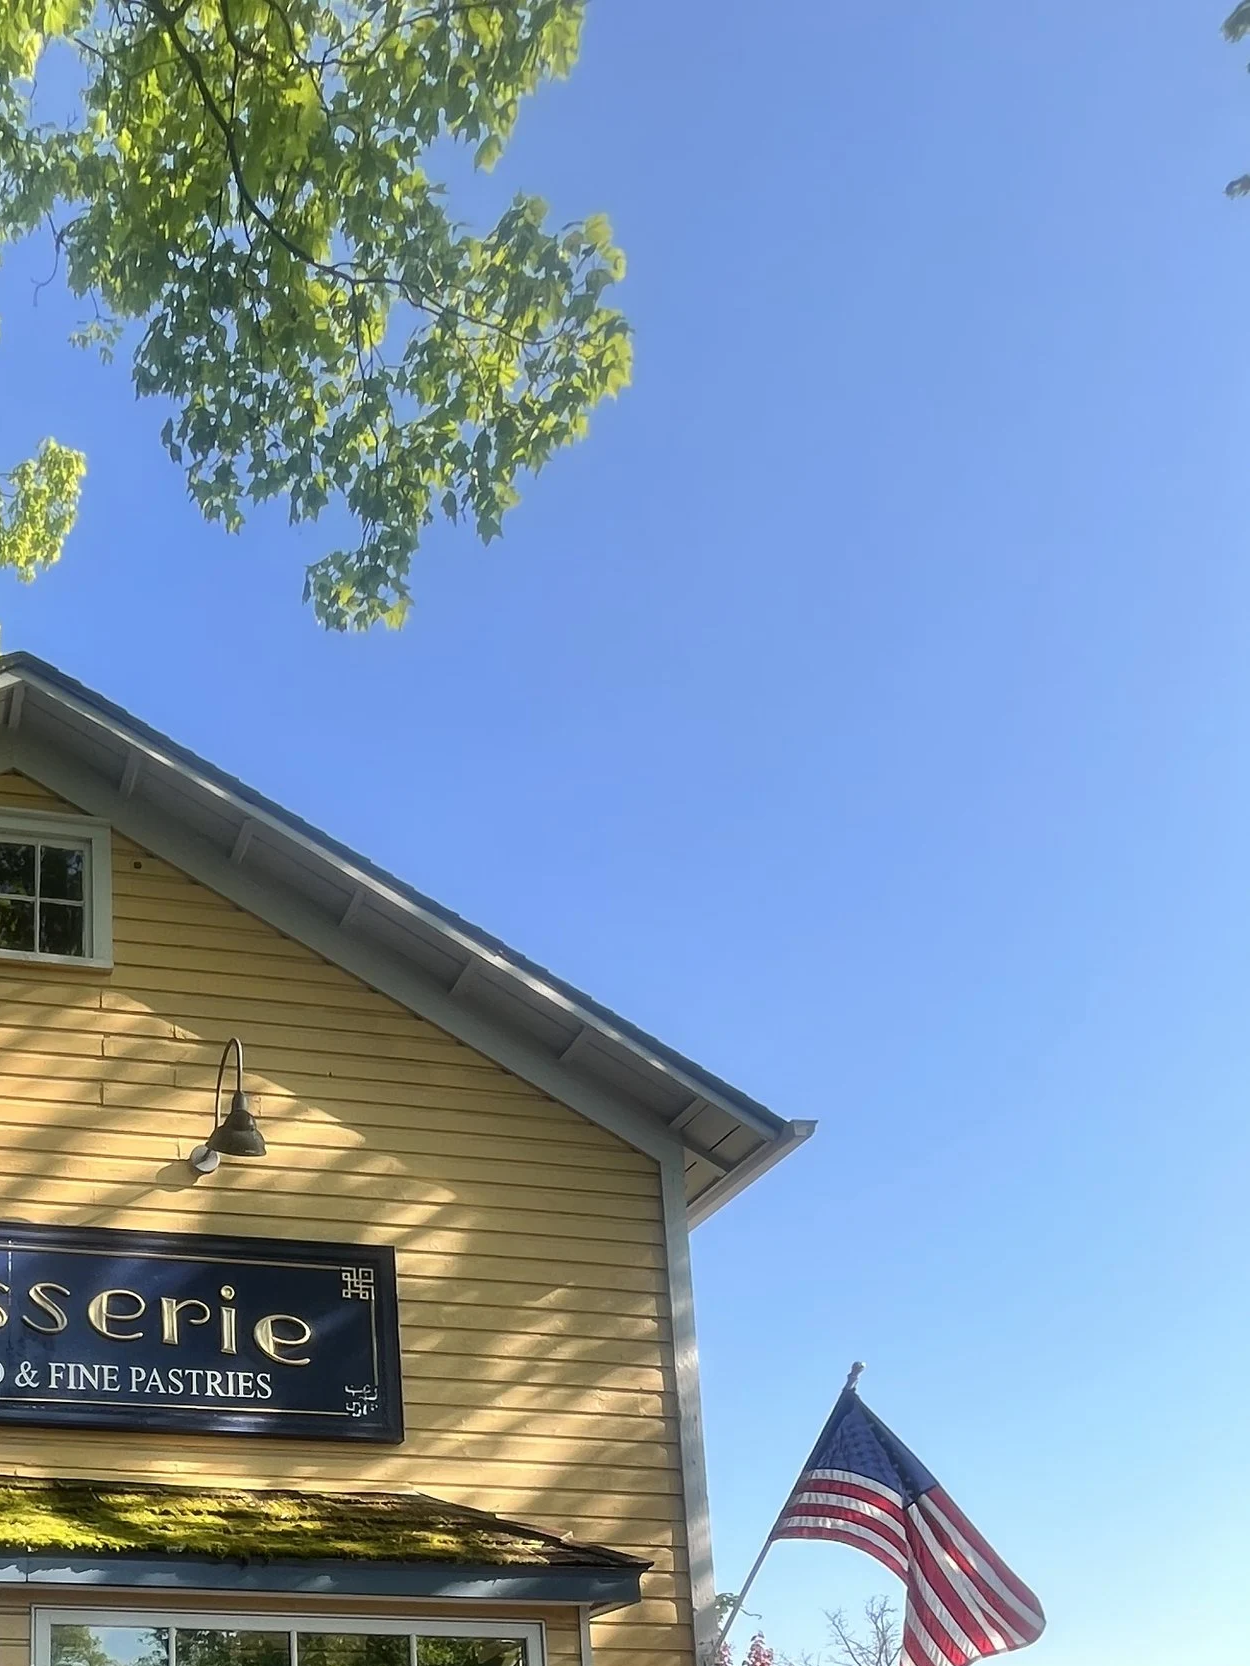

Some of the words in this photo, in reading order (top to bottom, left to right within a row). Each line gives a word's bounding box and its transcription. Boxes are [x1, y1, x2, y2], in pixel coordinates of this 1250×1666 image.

[14, 1360, 41, 1388] &
[48, 1362, 121, 1392] FINE
[129, 1366, 272, 1400] PASTRIES
